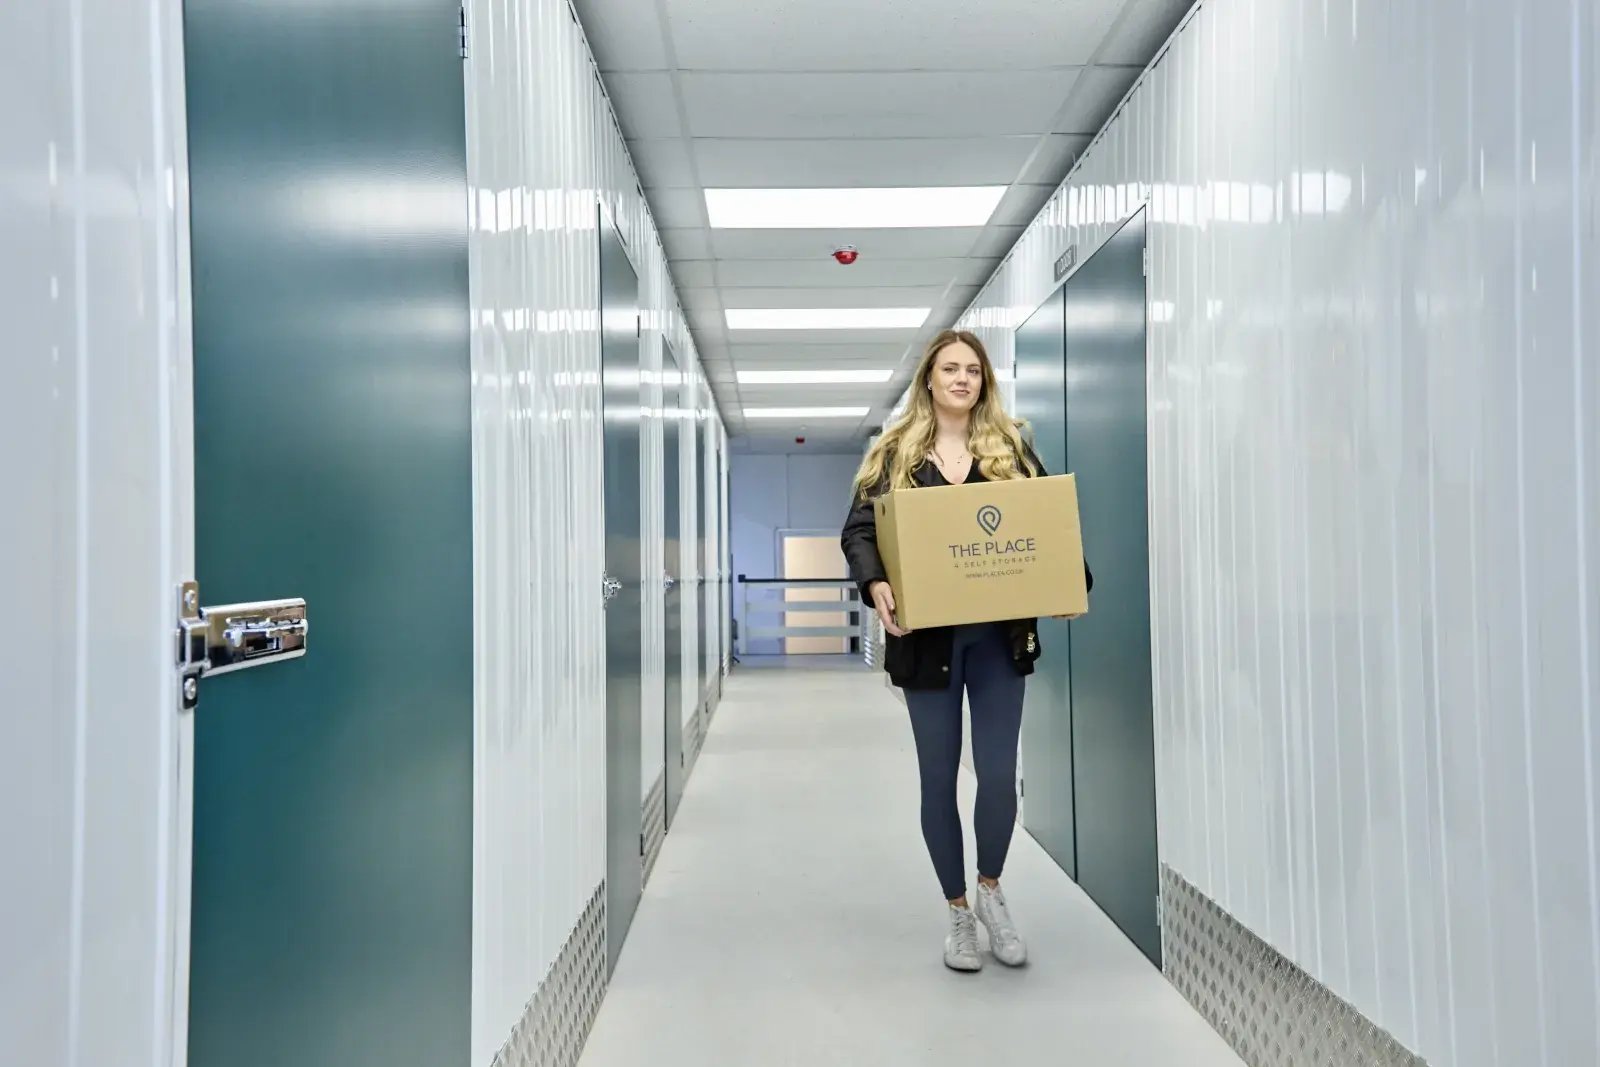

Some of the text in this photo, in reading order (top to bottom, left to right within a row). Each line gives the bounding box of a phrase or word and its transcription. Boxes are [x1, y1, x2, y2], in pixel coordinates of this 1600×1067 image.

[949, 538, 1036, 558] THE PLACE
[964, 560, 987, 568] SELF
[992, 556, 1036, 565] STORAGE
